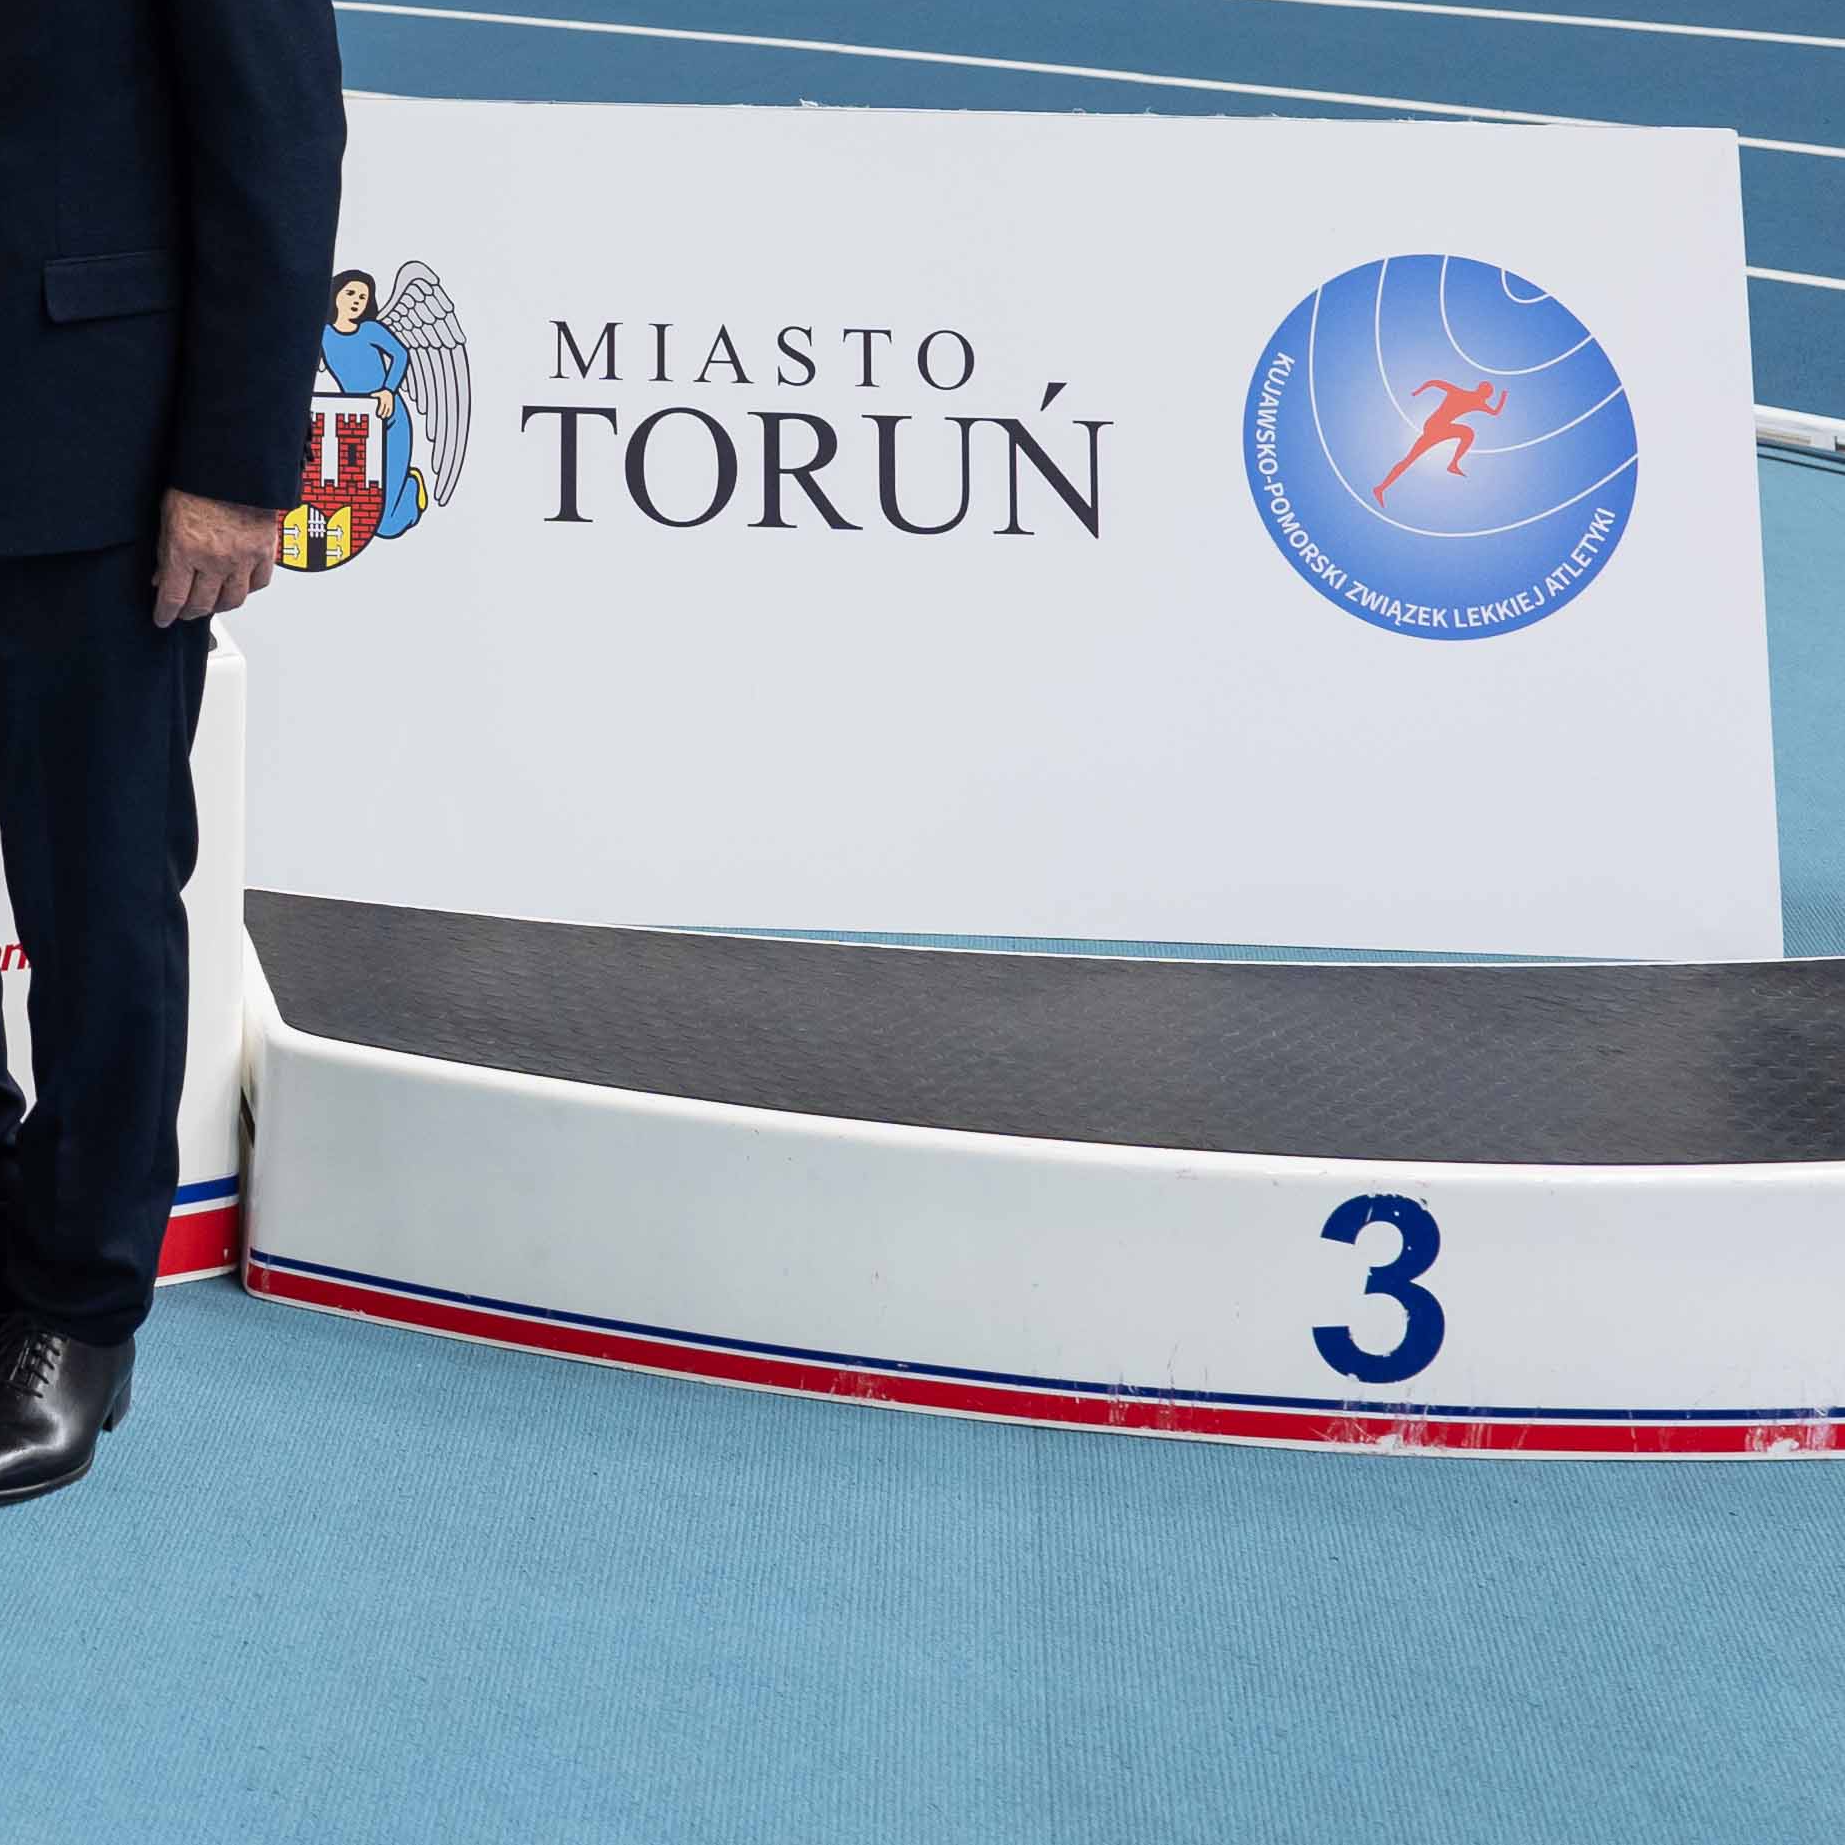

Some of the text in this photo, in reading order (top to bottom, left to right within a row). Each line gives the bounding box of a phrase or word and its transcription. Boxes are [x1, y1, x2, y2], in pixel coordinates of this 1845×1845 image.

[549, 319, 976, 391] MIASTO
[521, 381, 1115, 539] TORUŃ
[1256, 351, 1616, 628] KUJAWSKO-POMORSKI ZWIĄZEK LEKKIEJ ATLETYKI
[1311, 1193, 1445, 1384] 3
